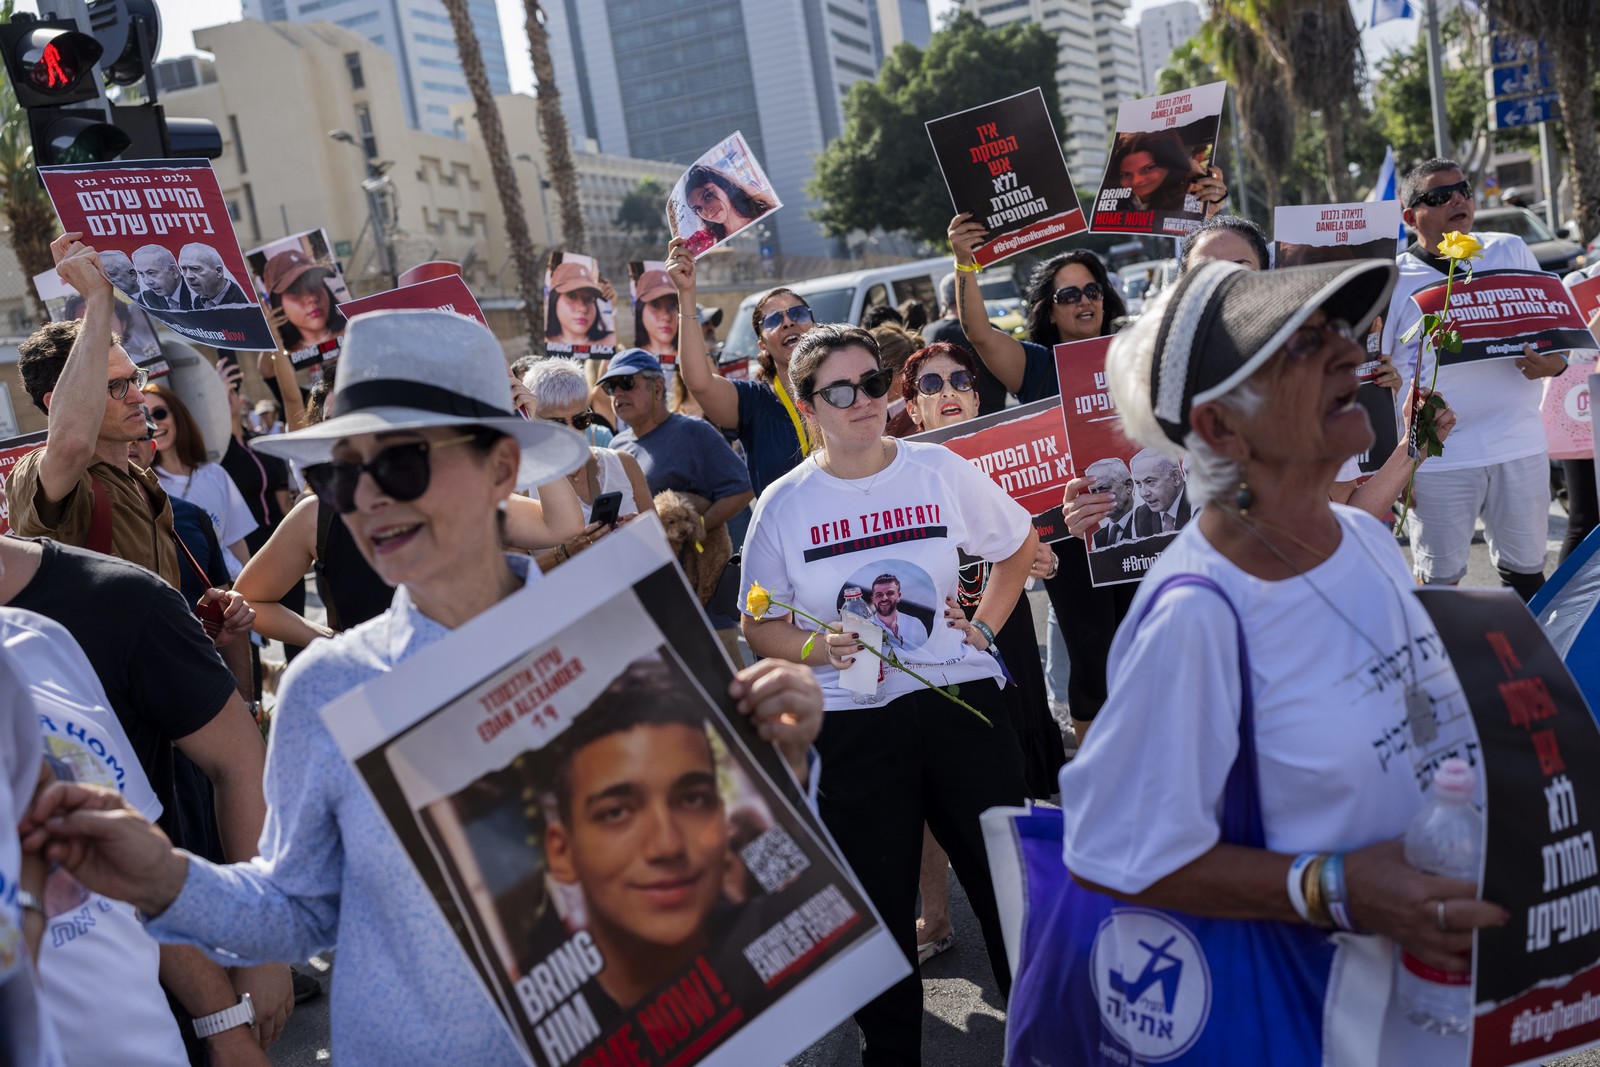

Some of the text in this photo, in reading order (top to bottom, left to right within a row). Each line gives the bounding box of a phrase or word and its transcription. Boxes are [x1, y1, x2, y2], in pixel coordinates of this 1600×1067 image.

[1151, 103, 1192, 120] DANIELA GILBOA
[976, 121, 999, 144] אין
[970, 135, 1018, 163] הפסקת
[987, 157, 1012, 176] אש
[75, 174, 192, 188] גלנט נתניהו גנץ
[992, 171, 1018, 194] ללא
[76, 187, 204, 211] החיים שלהם
[990, 185, 1034, 212] החזרת
[1097, 199, 1118, 212] HER
[1101, 187, 1132, 200] BRING
[86, 212, 215, 236] בידיים שלכם
[987, 197, 1048, 229] החטופים!
[1095, 211, 1123, 225] HOME
[1125, 209, 1155, 226] NOW!
[1316, 219, 1366, 231] DANIELA GILBOA
[1321, 208, 1363, 220] דניאלה גלבוע
[993, 223, 1065, 254] #BringThemHomeNow
[1336, 231, 1348, 243] (19)
[1450, 287, 1548, 306] אין הפסקת אש
[1502, 300, 1545, 317] החזרת
[1546, 301, 1571, 316] ללא
[291, 344, 320, 364] BRING
[1486, 339, 1552, 354] #BringThemHmeNow
[1031, 435, 1059, 463] אין
[999, 462, 1053, 492] החזרת
[810, 504, 941, 545] OFIR TZARFATI
[854, 527, 927, 550] KIDNAPPED
[476, 656, 586, 744] EDAN ALEXANDER
[531, 703, 559, 730] 19
[1544, 774, 1578, 833] ללא
[1541, 829, 1599, 893] החזרת
[1526, 885, 1600, 953] חטופים!
[515, 929, 604, 1026] BRING
[637, 955, 731, 1057] NOW!
[1509, 990, 1600, 1046] #BringThemHo
[534, 991, 602, 1067] HIM
